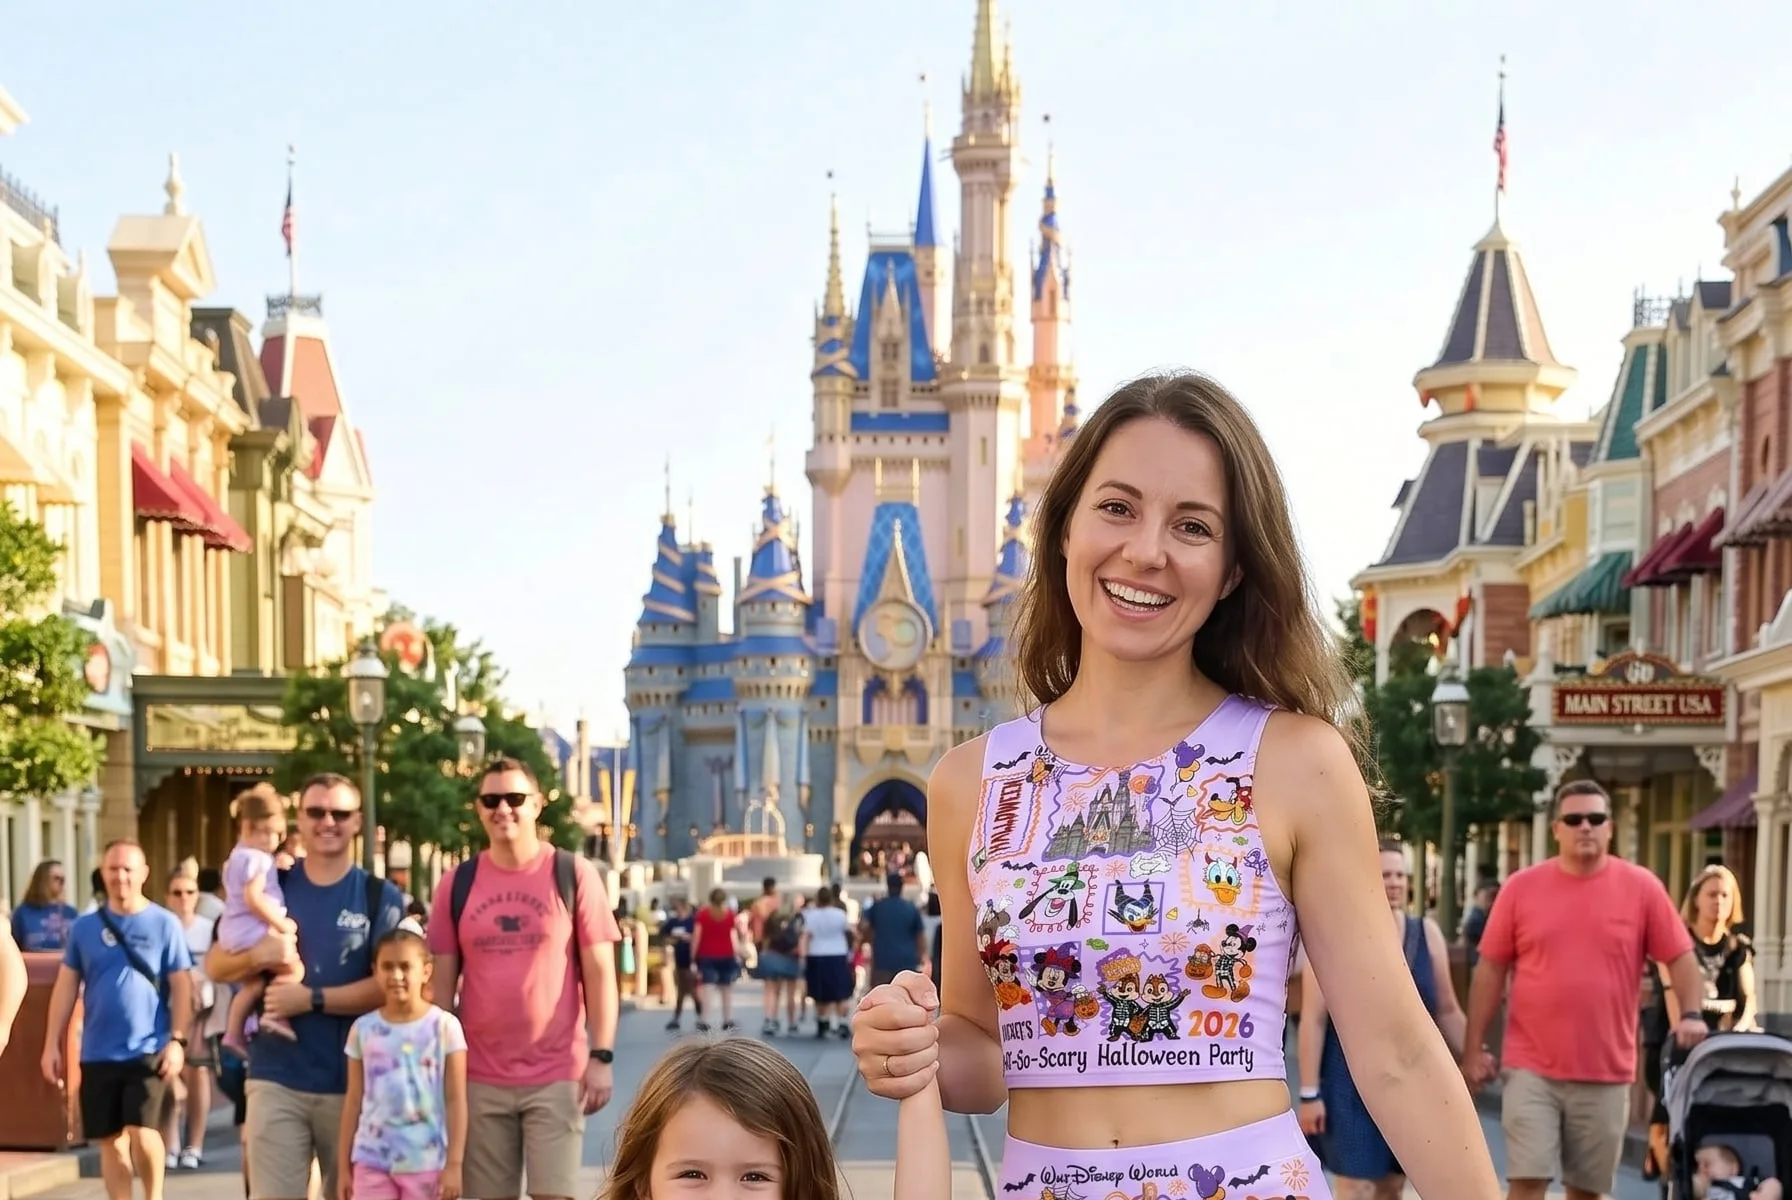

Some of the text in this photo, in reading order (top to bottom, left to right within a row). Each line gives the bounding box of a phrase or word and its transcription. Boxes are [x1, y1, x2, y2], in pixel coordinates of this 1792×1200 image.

[1565, 694, 1609, 714] MAIN
[1611, 694, 1676, 714] STREET
[1188, 1009, 1255, 1039] 2026
[1098, 1041, 1200, 1067] Halloween
[1209, 1043, 1254, 1073] Party
